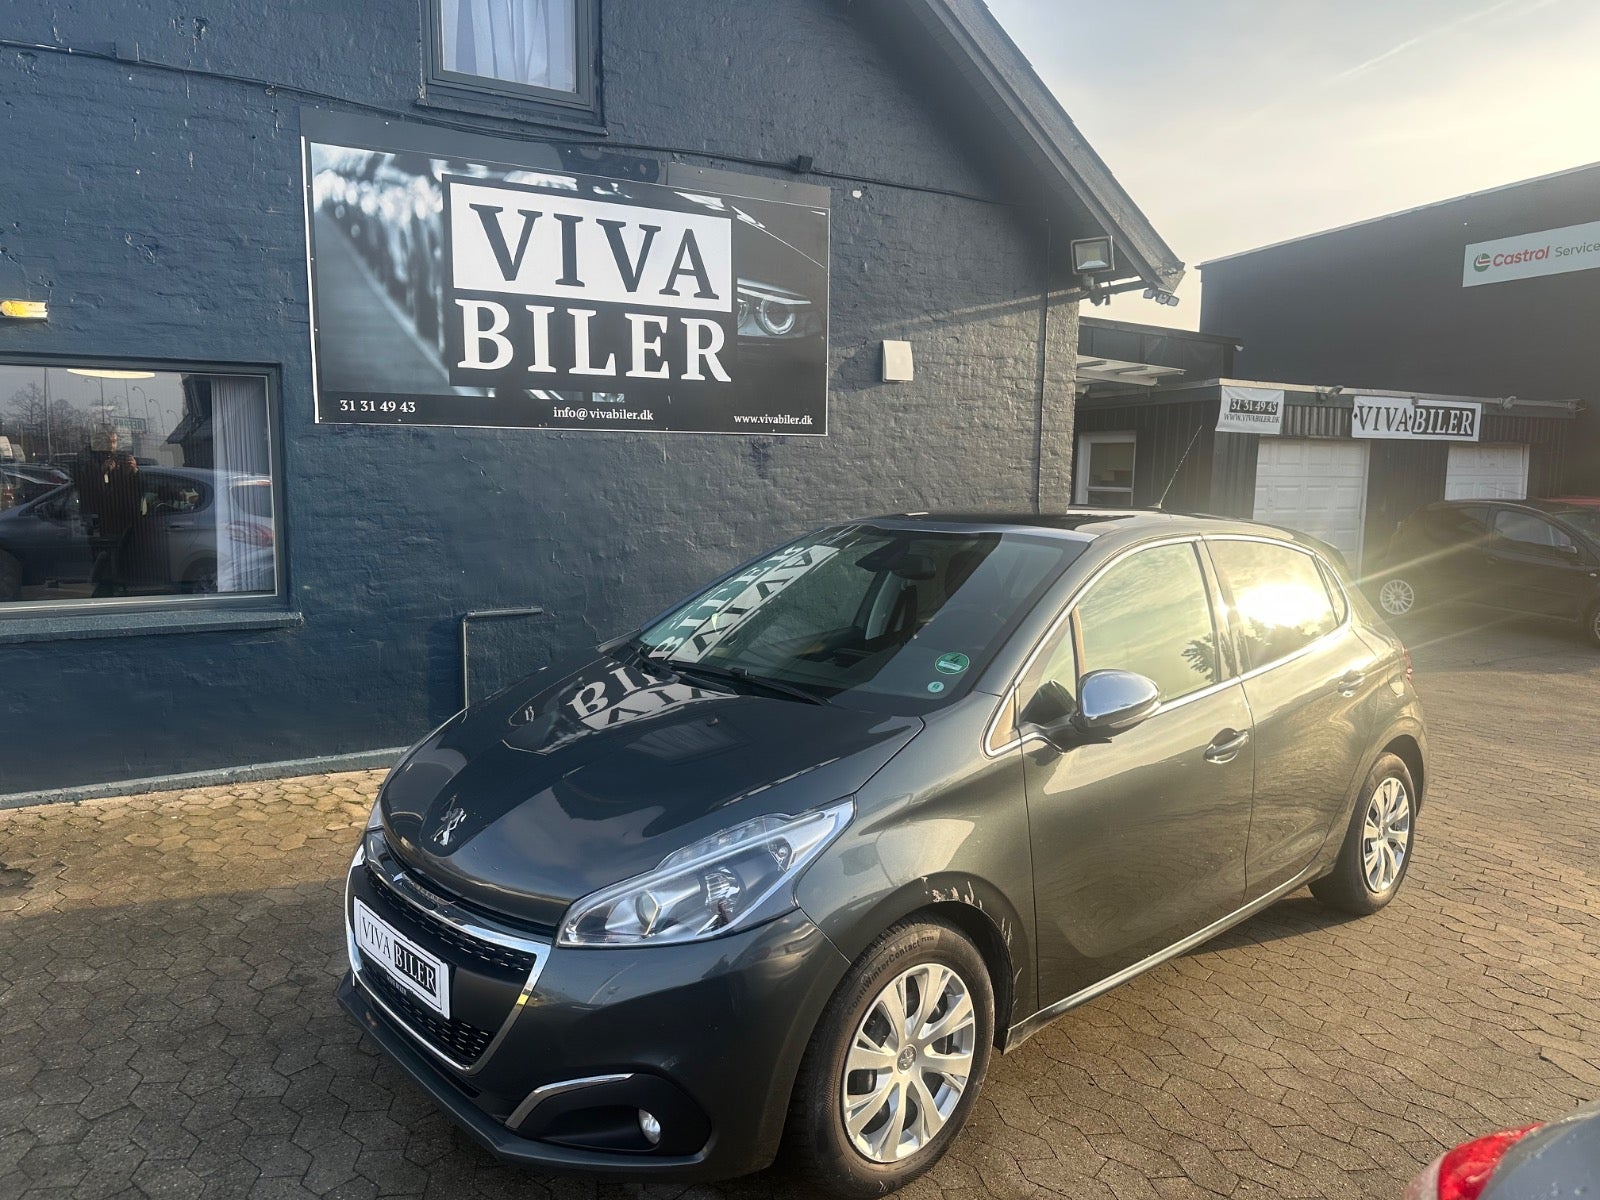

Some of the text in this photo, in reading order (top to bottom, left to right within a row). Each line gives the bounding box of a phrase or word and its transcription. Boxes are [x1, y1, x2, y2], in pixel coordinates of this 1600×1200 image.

[469, 203, 719, 300] VIVA
[1493, 242, 1600, 267] Castrol Service
[455, 299, 732, 382] BILER
[340, 399, 416, 413] 31 31 49 43
[553, 406, 654, 421] info@vivabiler.dk
[1231, 400, 1277, 413] 31 31 49 43
[733, 413, 813, 425] www.vivabiler.dk
[1357, 405, 1473, 435] VIVA BILER
[362, 917, 391, 959] VIVA
[395, 942, 436, 995] BILER
